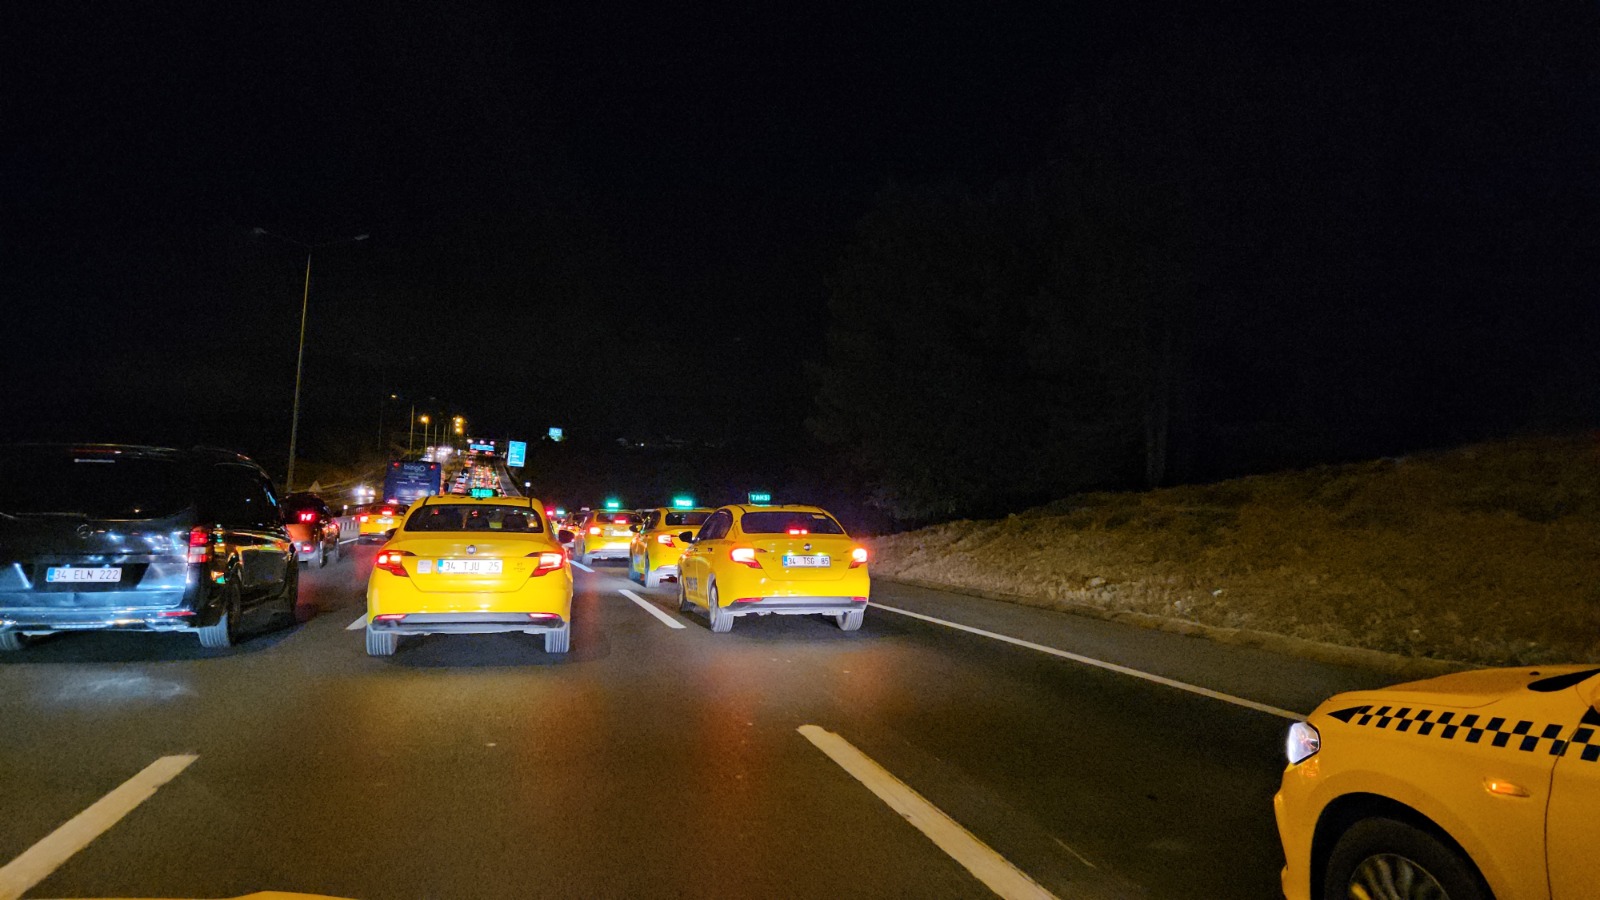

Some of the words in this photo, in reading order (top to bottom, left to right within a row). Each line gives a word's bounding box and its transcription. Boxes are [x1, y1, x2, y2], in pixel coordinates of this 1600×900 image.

[788, 557, 796, 565] 34
[803, 556, 815, 565] TSG
[445, 561, 456, 571] 34
[463, 561, 480, 571] TJU
[488, 561, 500, 571] 25
[55, 569, 67, 580] 34
[73, 569, 94, 580] ELN
[99, 569, 119, 580] 222
